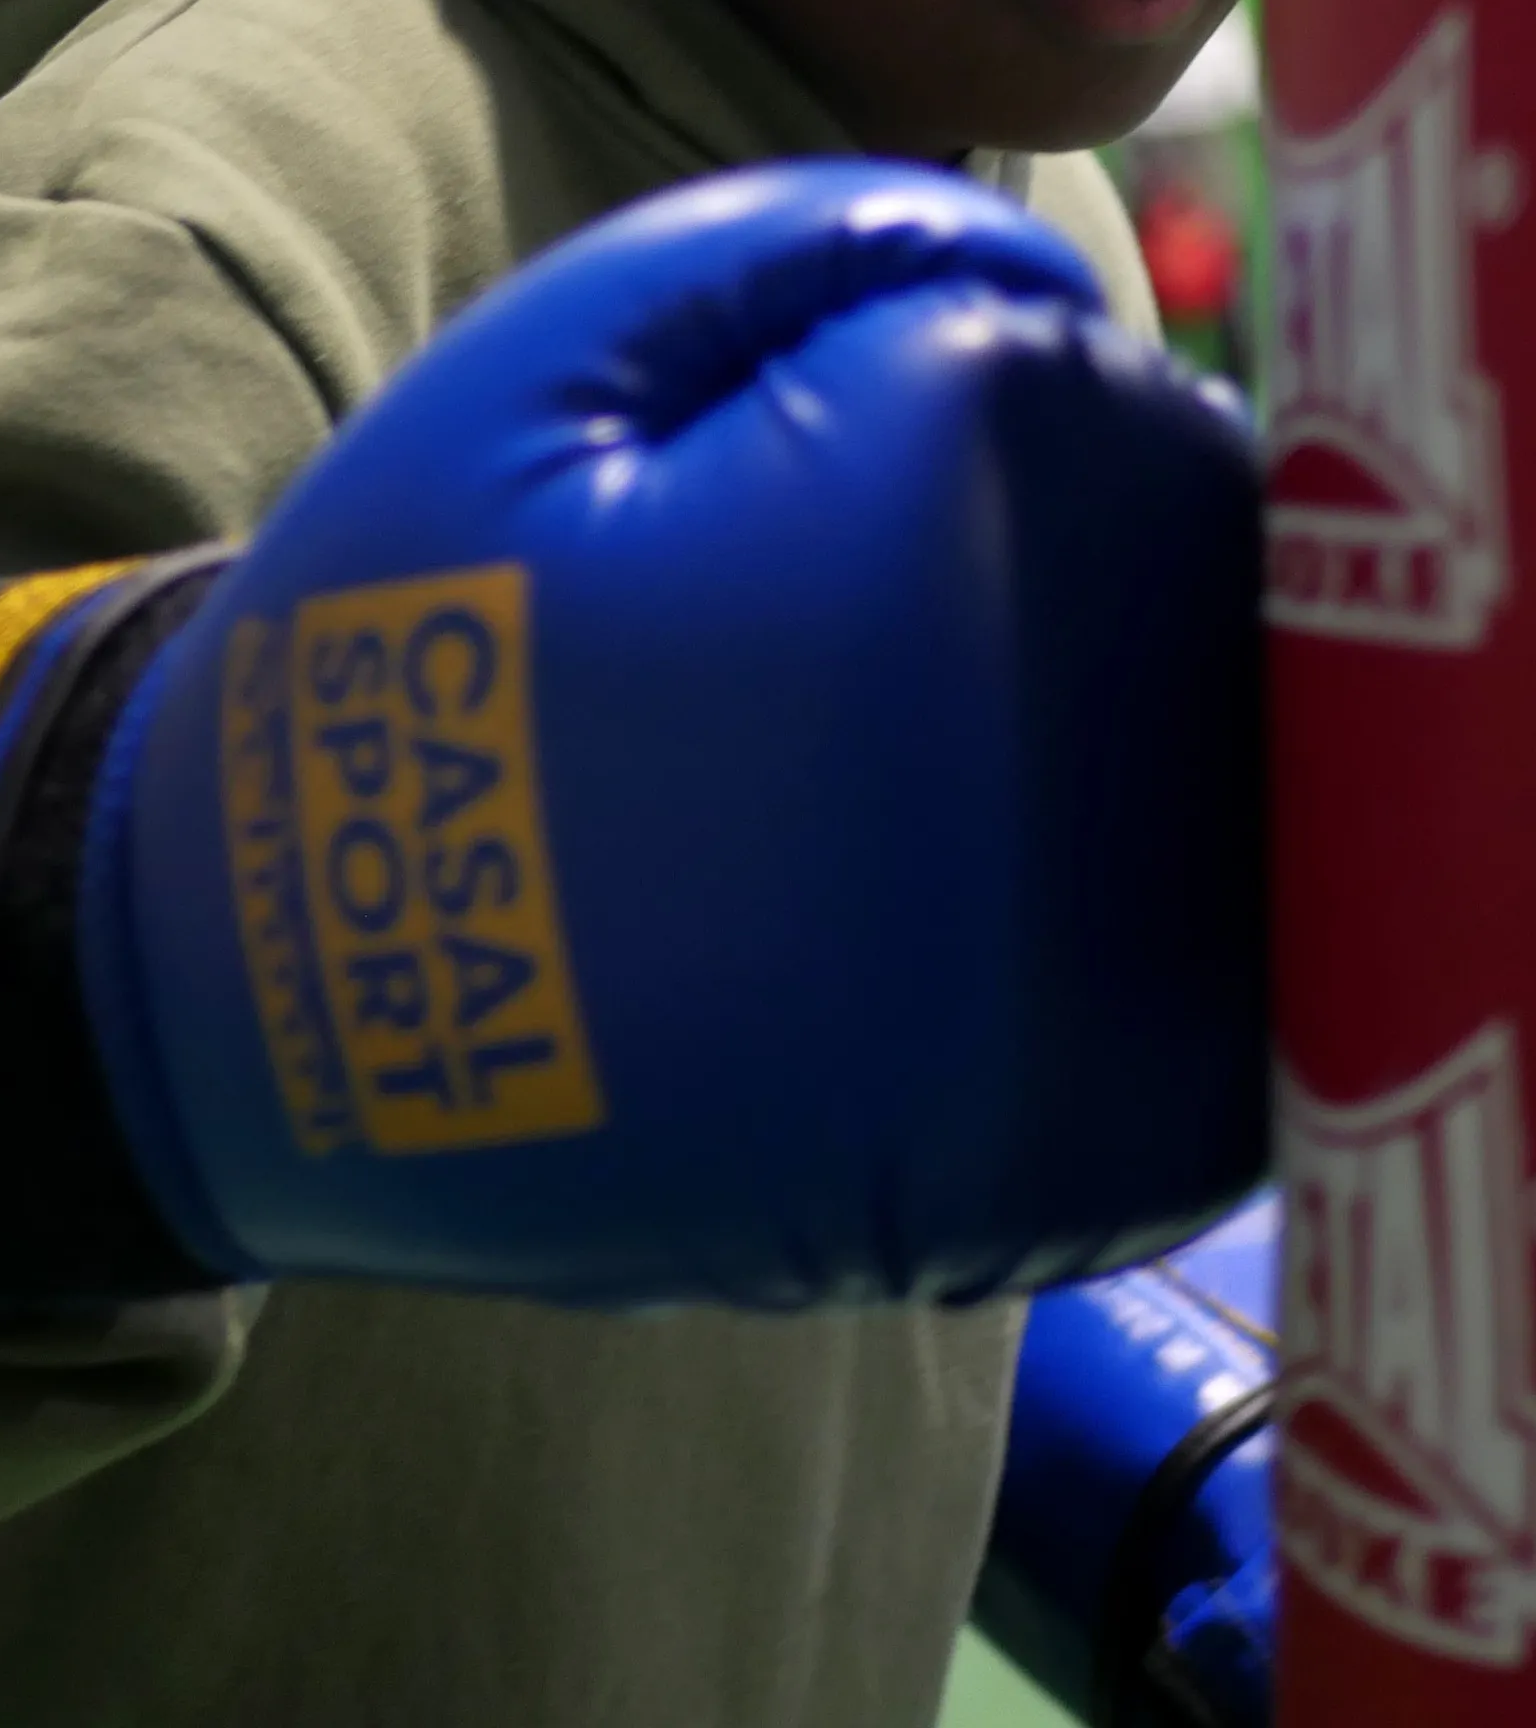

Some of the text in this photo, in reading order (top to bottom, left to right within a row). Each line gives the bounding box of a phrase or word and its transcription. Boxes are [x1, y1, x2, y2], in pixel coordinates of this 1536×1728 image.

[309, 630, 461, 1110] SPORT
[401, 607, 559, 1110] CASAL
[1280, 1092, 1529, 1529] ETAL
